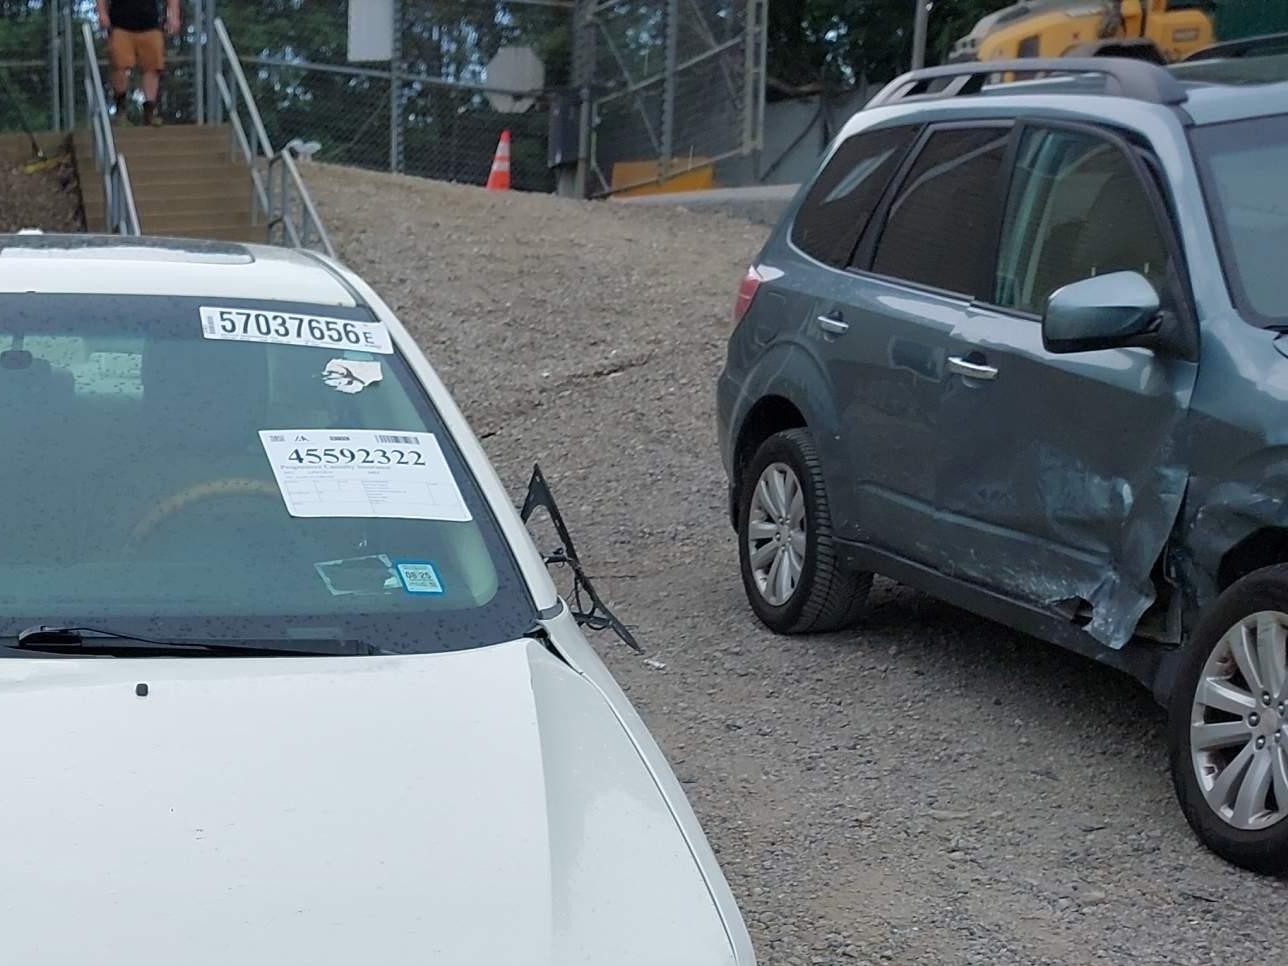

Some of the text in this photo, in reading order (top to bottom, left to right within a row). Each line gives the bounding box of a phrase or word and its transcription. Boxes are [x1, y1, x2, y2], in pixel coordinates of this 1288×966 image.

[219, 310, 361, 345] 57037656
[363, 331, 375, 344] E
[288, 448, 426, 466] 45592322
